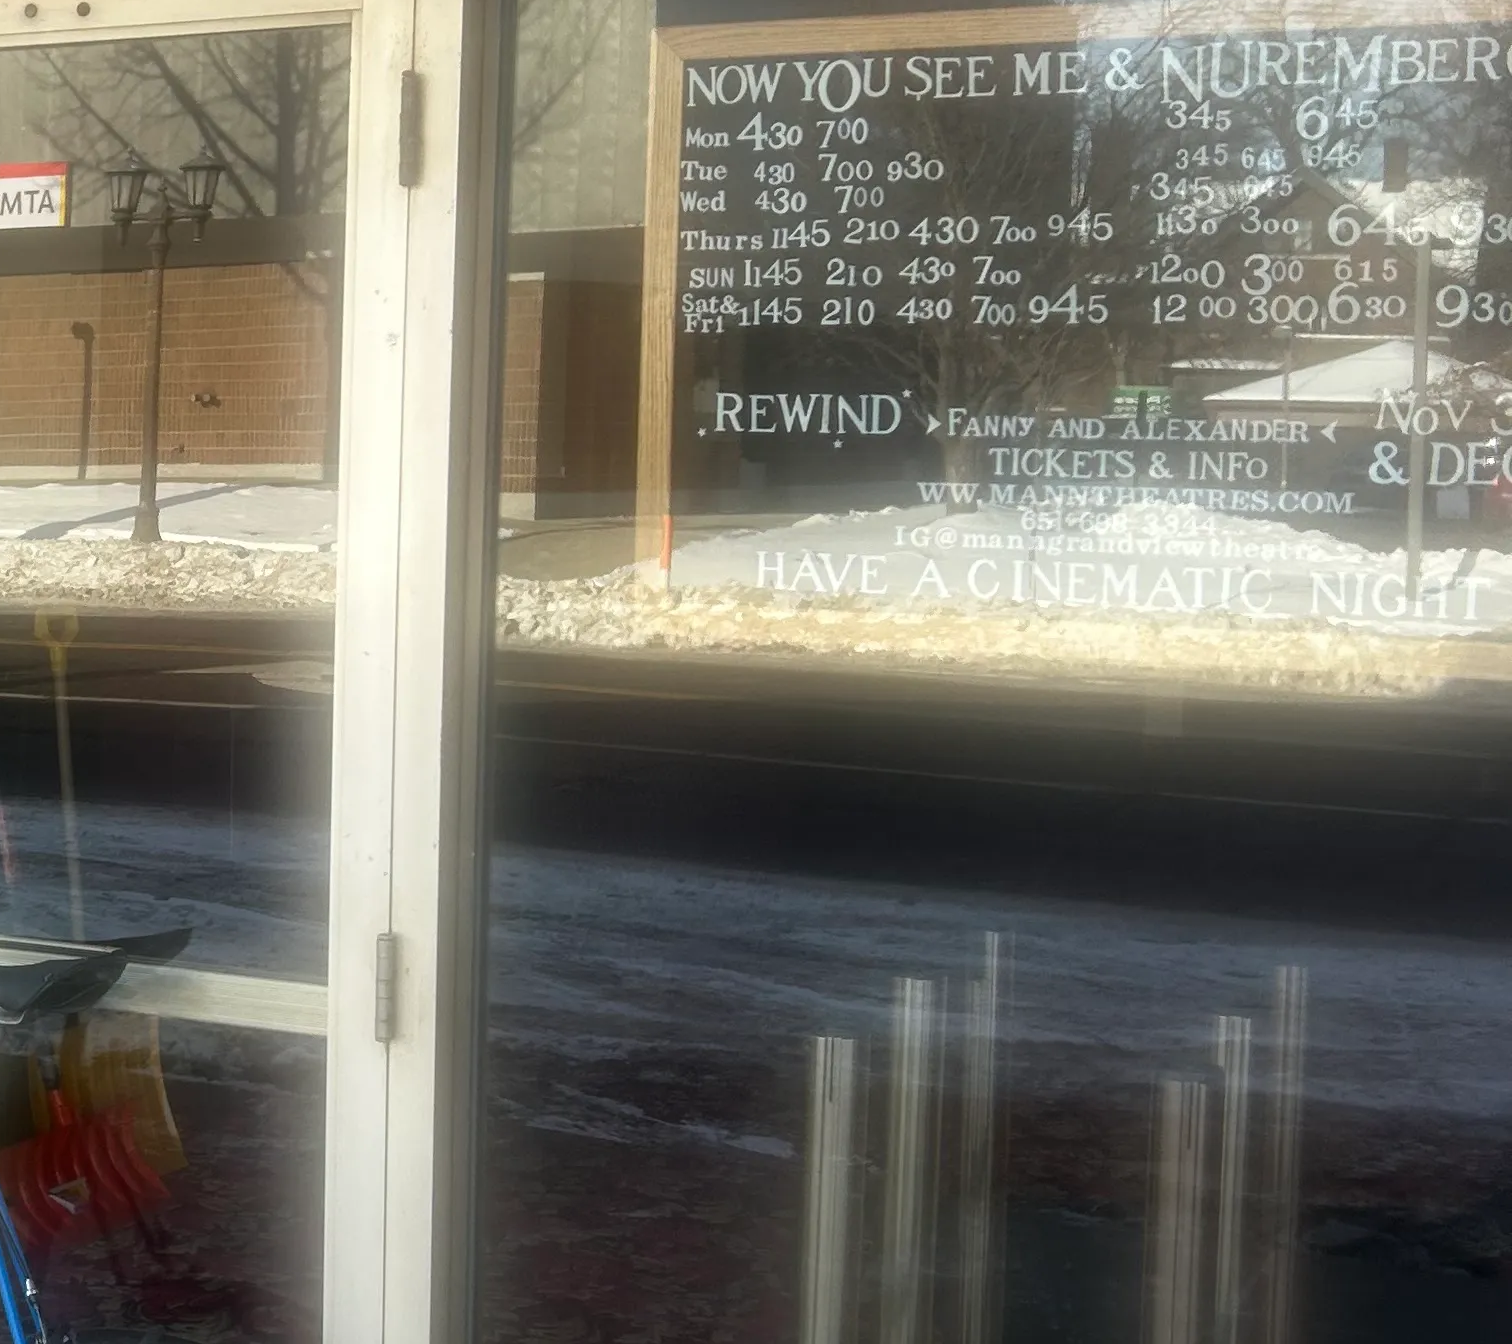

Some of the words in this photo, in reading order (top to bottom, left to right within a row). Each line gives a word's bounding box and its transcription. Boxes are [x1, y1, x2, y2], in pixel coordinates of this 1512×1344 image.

[687, 62, 785, 107] NOW
[793, 57, 891, 113] YOU
[904, 56, 997, 101] SEE
[1014, 51, 1088, 96] ME
[1104, 47, 1145, 92] &
[1160, 34, 1512, 104] NUREMBER
[685, 128, 730, 148] Mon
[736, 111, 803, 151] 430
[817, 117, 868, 150] 700
[1166, 100, 1232, 132] 345
[1296, 96, 1378, 141] 645
[681, 160, 728, 182] Tue
[754, 161, 795, 185] 430
[818, 153, 873, 182] 700
[887, 151, 945, 182] 930
[1176, 143, 1229, 170] 345
[1241, 146, 1286, 171] 645
[681, 191, 726, 213] Wed
[755, 187, 808, 214] 430
[834, 185, 884, 214] 700
[1150, 172, 1215, 206] 345
[681, 230, 762, 251] Thurs
[843, 217, 900, 244] 210
[908, 216, 979, 245] 430
[989, 215, 1037, 245] 700
[1048, 207, 1115, 245] 945
[1241, 206, 1300, 234] 300
[689, 266, 734, 289] SUN
[826, 258, 882, 287] 210
[899, 256, 956, 285] 430
[973, 255, 1021, 286] 700
[1150, 253, 1225, 289] 1200
[1241, 252, 1304, 296] 300
[1336, 257, 1397, 282] 615
[821, 298, 875, 327] 210
[896, 297, 953, 325] 430
[971, 295, 1016, 326] 700
[1028, 284, 1116, 326] 945
[1247, 294, 1319, 325] 300
[1328, 280, 1407, 324] 630
[714, 392, 902, 435] REWIND
[1048, 417, 1105, 438] AND
[1120, 418, 1310, 444] ALEXANDER
[988, 447, 1137, 480] TICKETS
[1149, 454, 1173, 479] &
[1369, 441, 1410, 486] &
[757, 551, 888, 595] HAVE
[912, 558, 951, 598] A
[967, 559, 1272, 613] CINEMATIC
[1310, 573, 1492, 620] NIGHT
